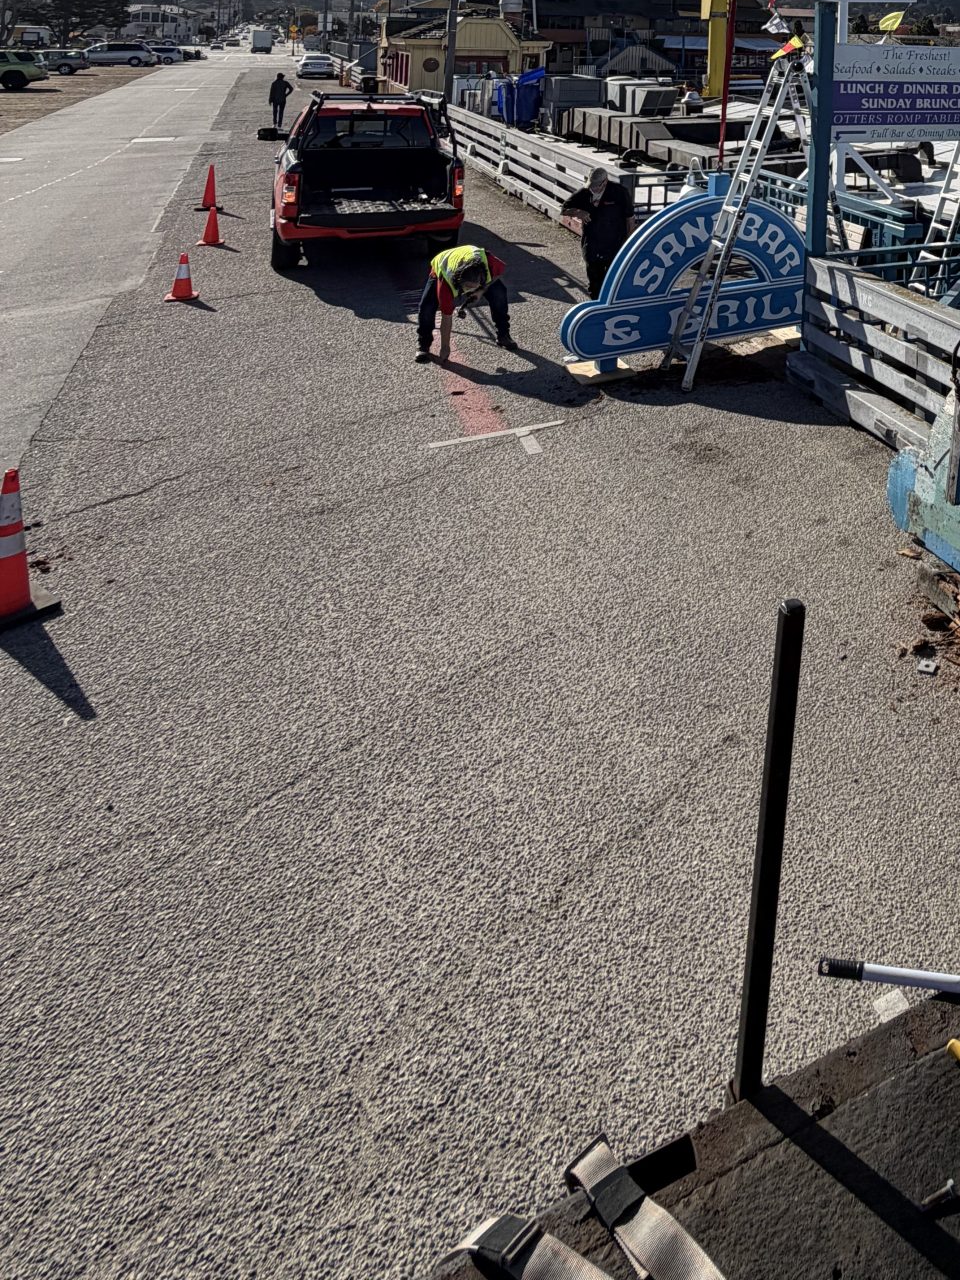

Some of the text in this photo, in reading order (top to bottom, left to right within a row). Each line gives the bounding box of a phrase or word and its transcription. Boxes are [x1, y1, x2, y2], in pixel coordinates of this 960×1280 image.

[883, 50, 951, 61] The Freshest!
[833, 62, 876, 79] Seafood
[883, 64, 916, 75] Salads
[926, 65, 957, 76] Steaks
[840, 84, 884, 94] LUNCH
[888, 84, 898, 94] &
[903, 84, 948, 95] DINNER
[861, 98, 912, 109] SUNDAY
[834, 113, 883, 124] OTTERS
[887, 114, 922, 124] ROMP
[870, 129, 888, 138] Full
[889, 130, 904, 138] Bar
[907, 129, 915, 138] &
[916, 128, 945, 140] Dining
[633, 212, 801, 294] SANDBAR
[602, 314, 641, 346] &
